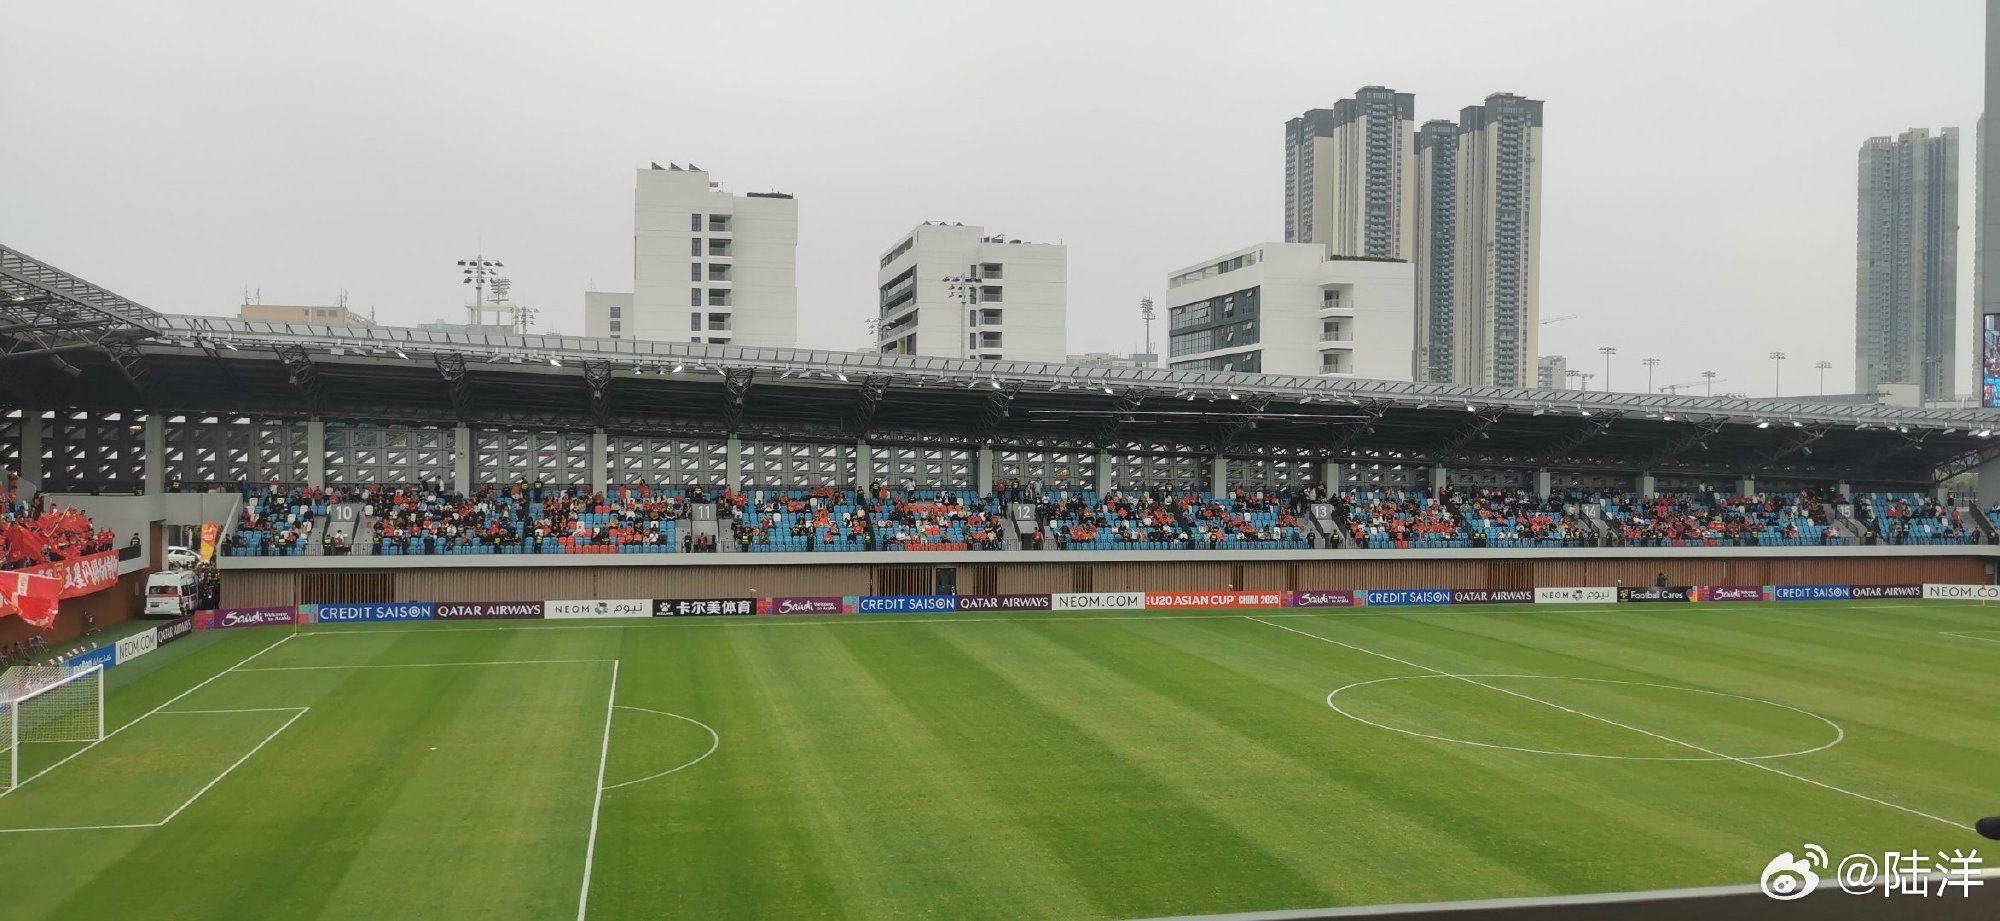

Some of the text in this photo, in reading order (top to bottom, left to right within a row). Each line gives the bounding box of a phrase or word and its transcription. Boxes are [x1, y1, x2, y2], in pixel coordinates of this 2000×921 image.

[335, 506, 353, 521] 10
[697, 506, 711, 520] 11
[1016, 505, 1031, 519] 12
[1313, 505, 1328, 518] 13
[1583, 504, 1597, 518] 14
[1839, 505, 1852, 518] 15
[1368, 591, 1450, 603] CREDIT SAISON
[1454, 591, 1532, 602] QATAR AIRWAYS
[1630, 590, 1683, 599] Football Cares
[1776, 587, 1850, 598] CREDIT SAISON
[1853, 586, 1920, 597] QATAR AIRWAYS
[860, 598, 955, 610] CREDIT SAISON
[960, 597, 1049, 609] QATAR AIRWAYS
[1059, 596, 1138, 608] NEOM.COM
[1150, 597, 1173, 605] U20
[1174, 596, 1209, 605] ASIAN
[1211, 595, 1234, 605] CUP
[1238, 595, 1259, 604] CHINA
[1260, 594, 1279, 604] 2025
[319, 605, 431, 619] CREDIT SAISON
[437, 604, 541, 617] QATAR AIRWAYS
[555, 605, 590, 614] NEOM
[613, 602, 643, 614] نيوم
[676, 600, 752, 615] 卡尔美体育
[157, 619, 192, 643] QATAR AIRWAYS
